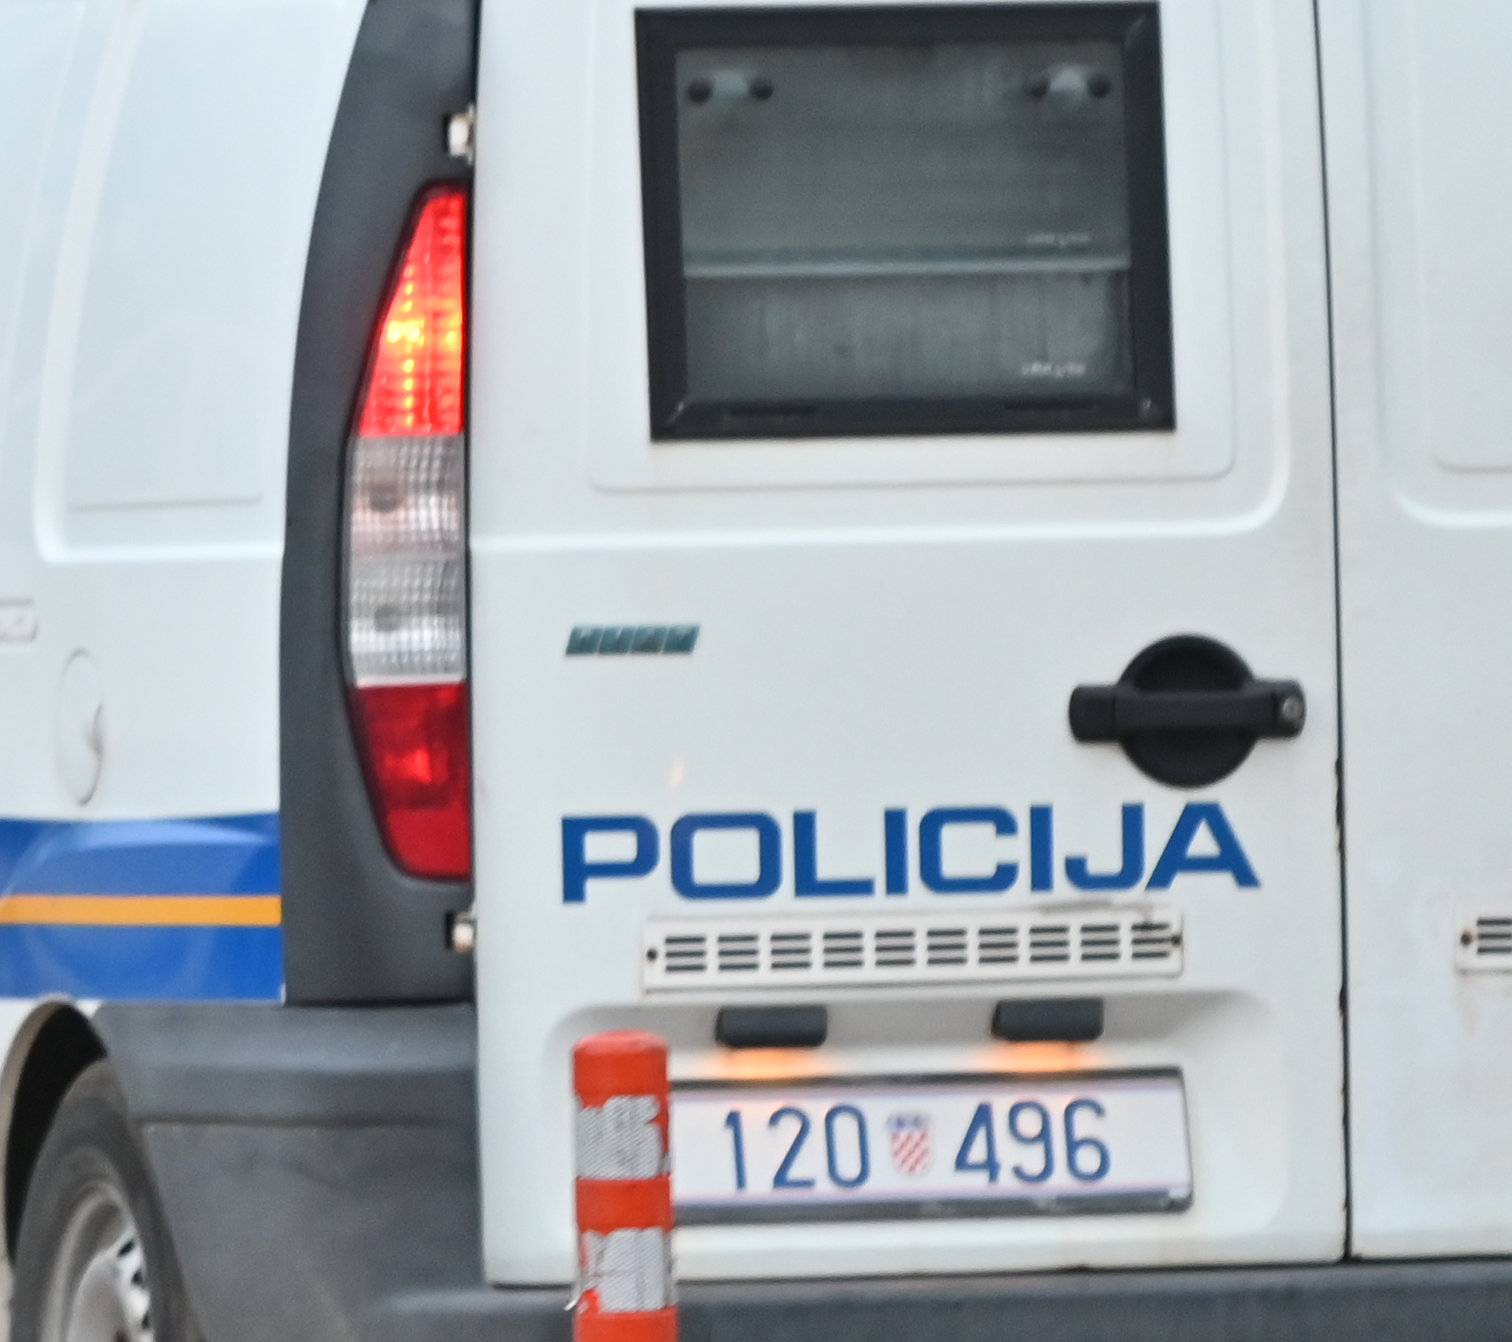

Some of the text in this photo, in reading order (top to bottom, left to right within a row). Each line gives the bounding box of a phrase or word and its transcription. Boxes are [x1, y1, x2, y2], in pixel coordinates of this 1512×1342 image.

[561, 801, 1261, 904] POLICIJA
[724, 1098, 1111, 1191] 120 496
